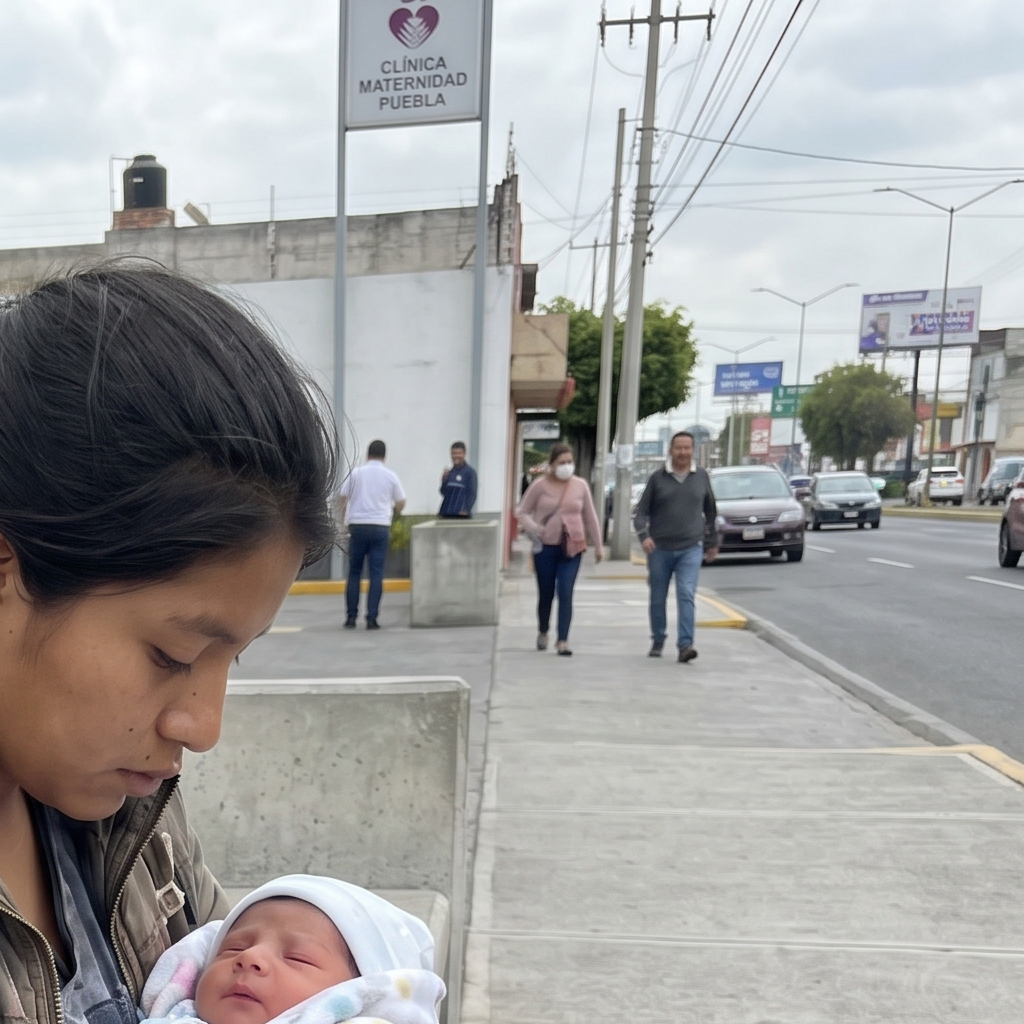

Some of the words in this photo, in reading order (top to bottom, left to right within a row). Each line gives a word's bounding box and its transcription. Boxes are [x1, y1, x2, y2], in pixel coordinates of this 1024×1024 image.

[380, 56, 447, 74] CLÍNICA
[359, 72, 467, 94] MATERNIDAD
[379, 93, 446, 110] PUEBLA
